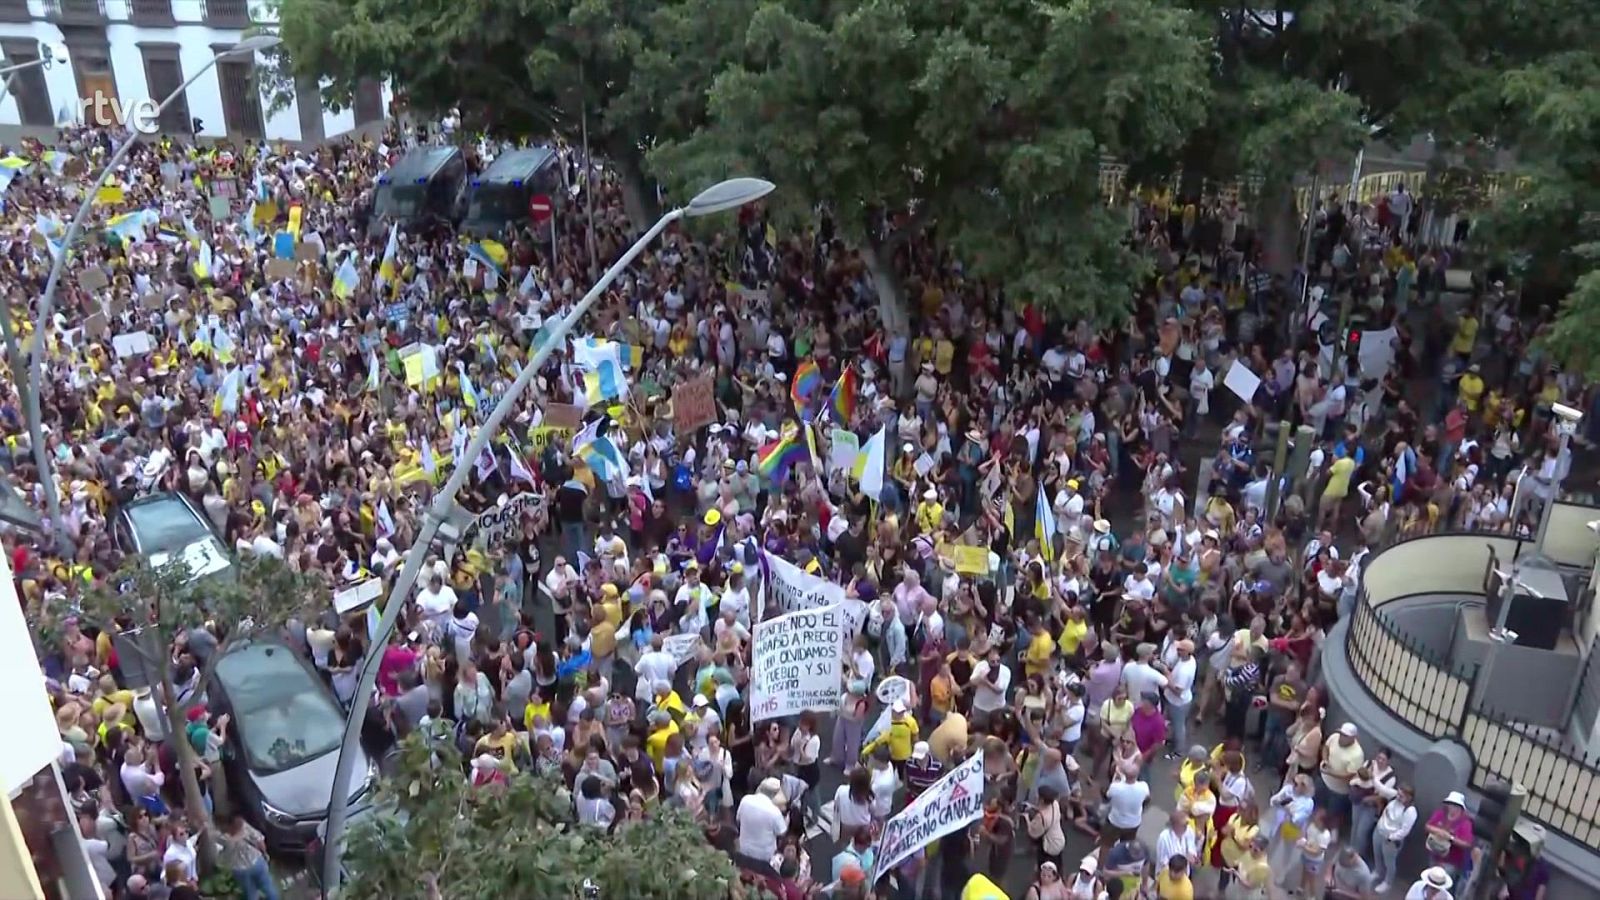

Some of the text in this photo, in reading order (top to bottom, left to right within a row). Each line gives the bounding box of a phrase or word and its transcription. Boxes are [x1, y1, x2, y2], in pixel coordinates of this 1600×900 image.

[787, 585, 803, 597] una
[807, 592, 830, 606] vida
[823, 612, 839, 628] EL
[791, 632, 801, 646] A
[803, 630, 839, 646] PRECIO
[780, 646, 837, 664] OLVIDAMOS
[805, 662, 814, 676] Y
[816, 662, 832, 676] SU
[924, 796, 941, 819] UN
